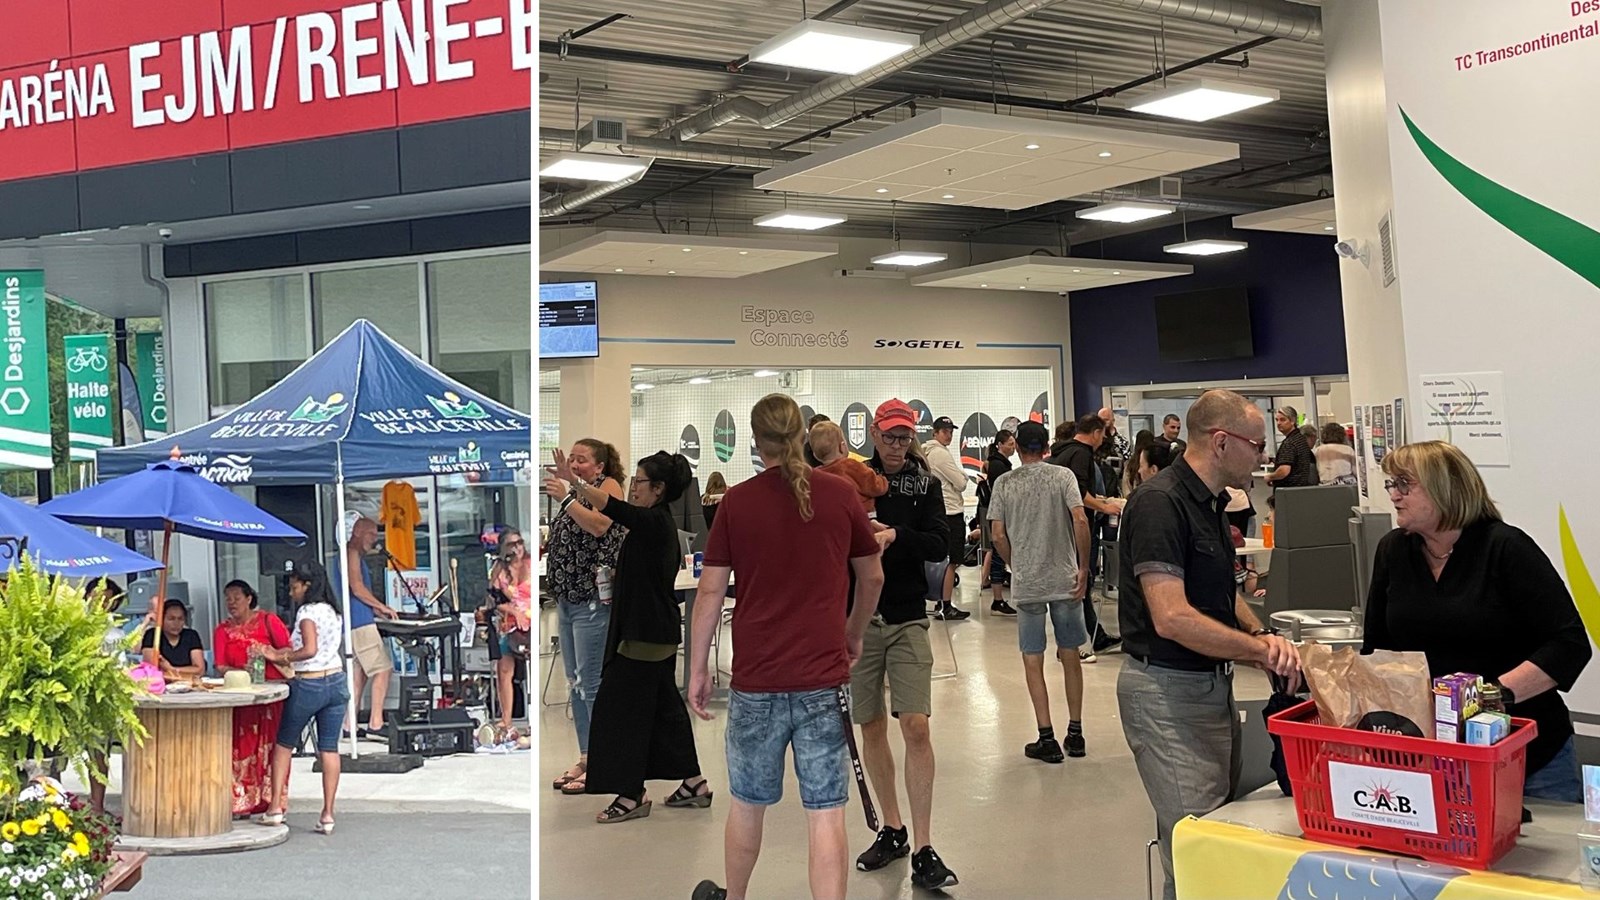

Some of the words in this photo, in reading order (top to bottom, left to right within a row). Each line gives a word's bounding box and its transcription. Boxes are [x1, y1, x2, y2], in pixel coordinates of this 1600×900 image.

[1455, 55, 1473, 71] TC
[1476, 20, 1599, 67] Transcontinental
[0, 59, 115, 130] ARÉNA
[740, 305, 815, 327] Espace
[2, 277, 26, 381] Desjardins
[750, 329, 849, 348] Connecté
[152, 336, 166, 402] Desjardins
[68, 382, 108, 398] Halte
[74, 402, 106, 418] vélo
[233, 409, 272, 424] VILLE
[359, 408, 412, 422] VILLE
[412, 408, 434, 419] DE
[210, 423, 339, 438] BEAUCEVILLE
[373, 418, 529, 434] BEAUCEVILLE
[180, 452, 208, 465] entrée
[73, 556, 112, 567] ULTRA
[1353, 790, 1417, 815] C.A.B.
